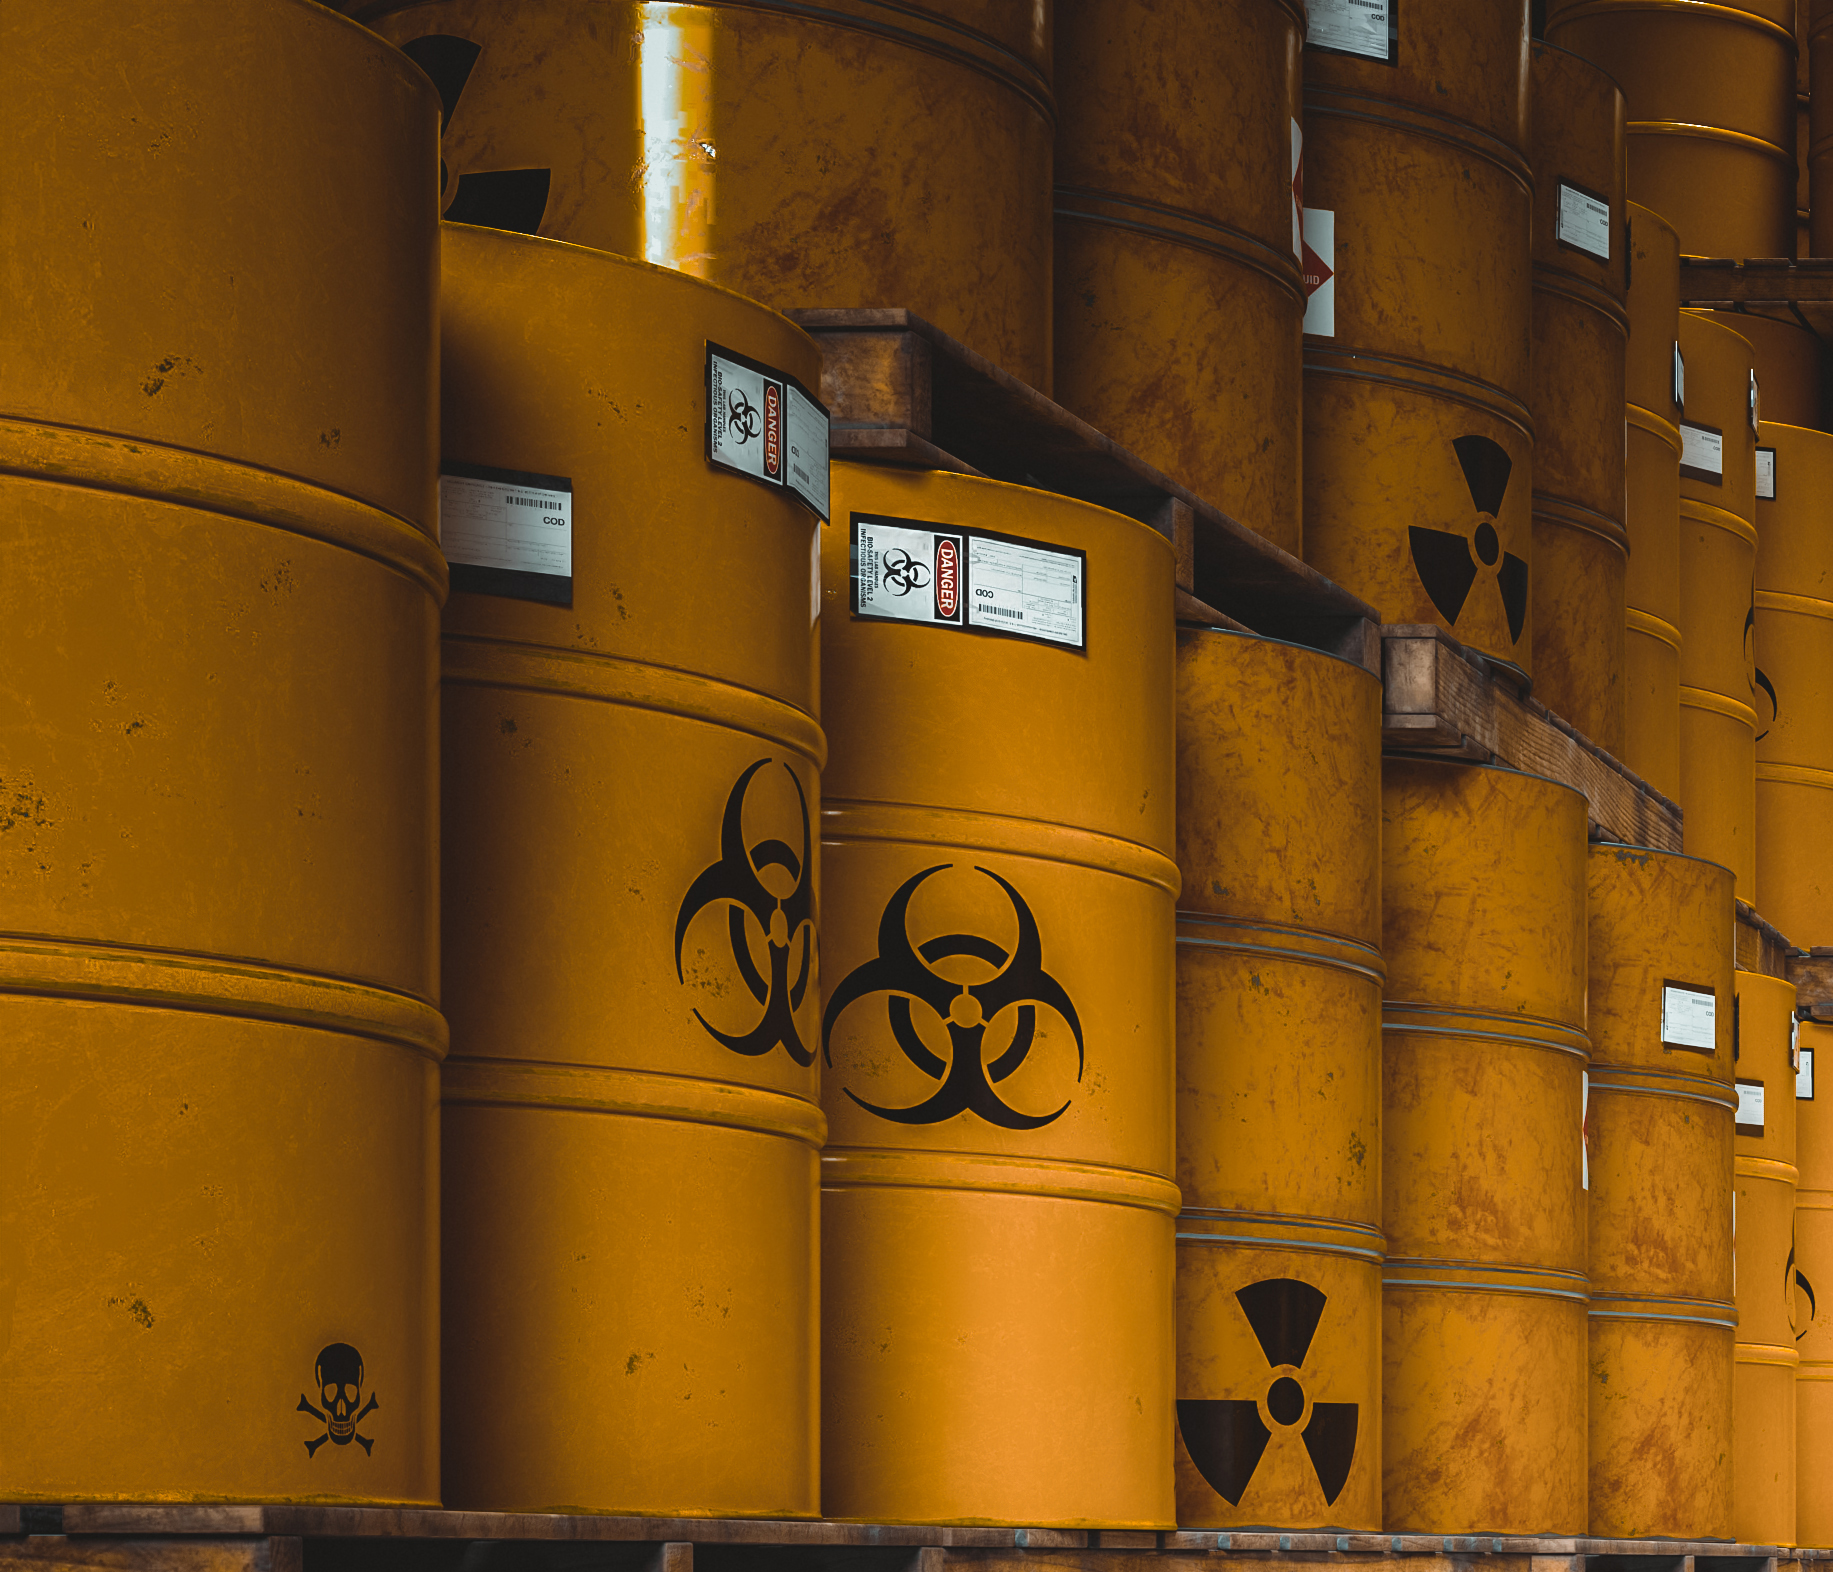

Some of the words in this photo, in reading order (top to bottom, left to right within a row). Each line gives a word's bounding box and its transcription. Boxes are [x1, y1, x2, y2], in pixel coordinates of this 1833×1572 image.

[1371, 13, 1385, 22] COD
[1303, 274, 1320, 286] UID
[767, 395, 778, 466] DANGER
[543, 516, 566, 527] COD
[941, 548, 953, 609] DANGER
[975, 589, 994, 598] COD
